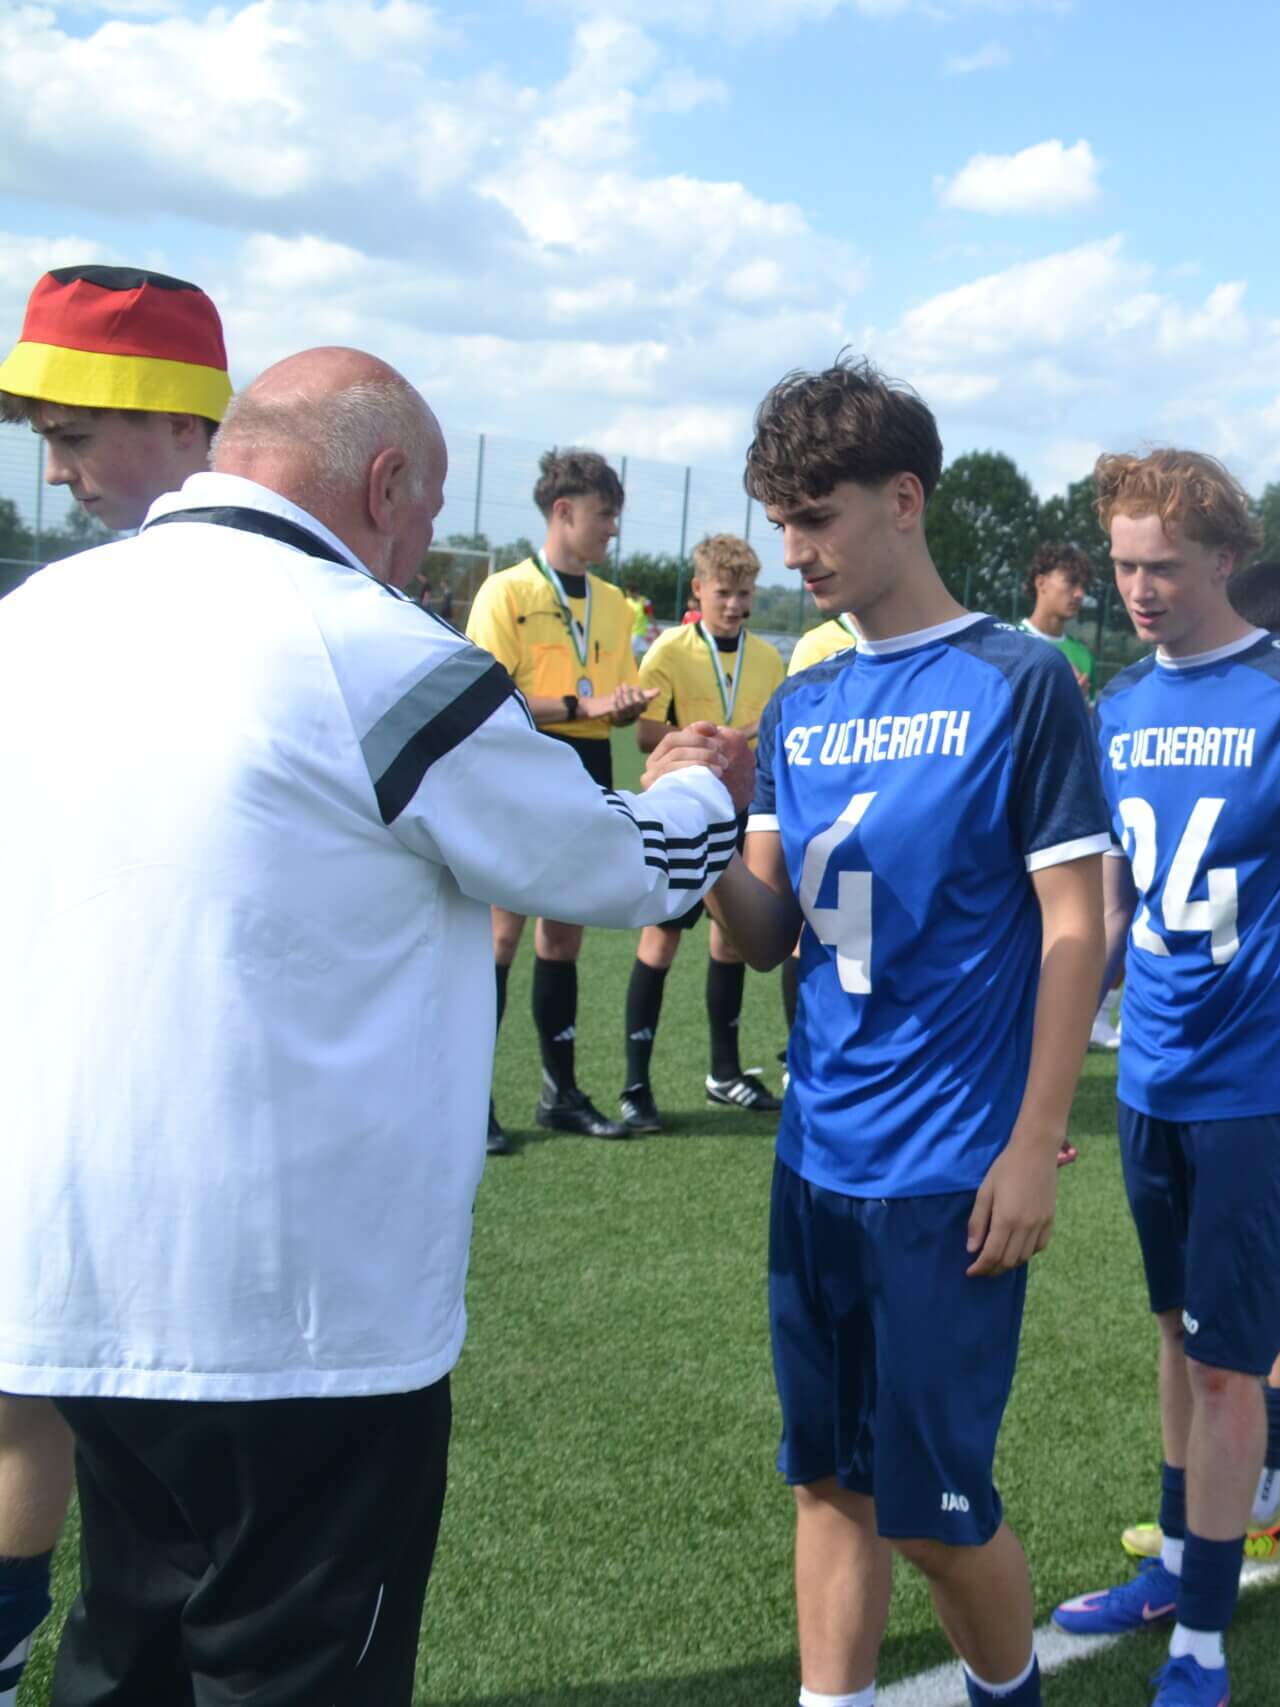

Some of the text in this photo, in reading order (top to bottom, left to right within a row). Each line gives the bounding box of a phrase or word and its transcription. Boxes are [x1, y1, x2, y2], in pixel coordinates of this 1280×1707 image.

[784, 710, 971, 766] SC UCKERATH
[1130, 726, 1256, 768] UCKERATH
[800, 791, 879, 994] 4
[1118, 796, 1240, 965] 24
